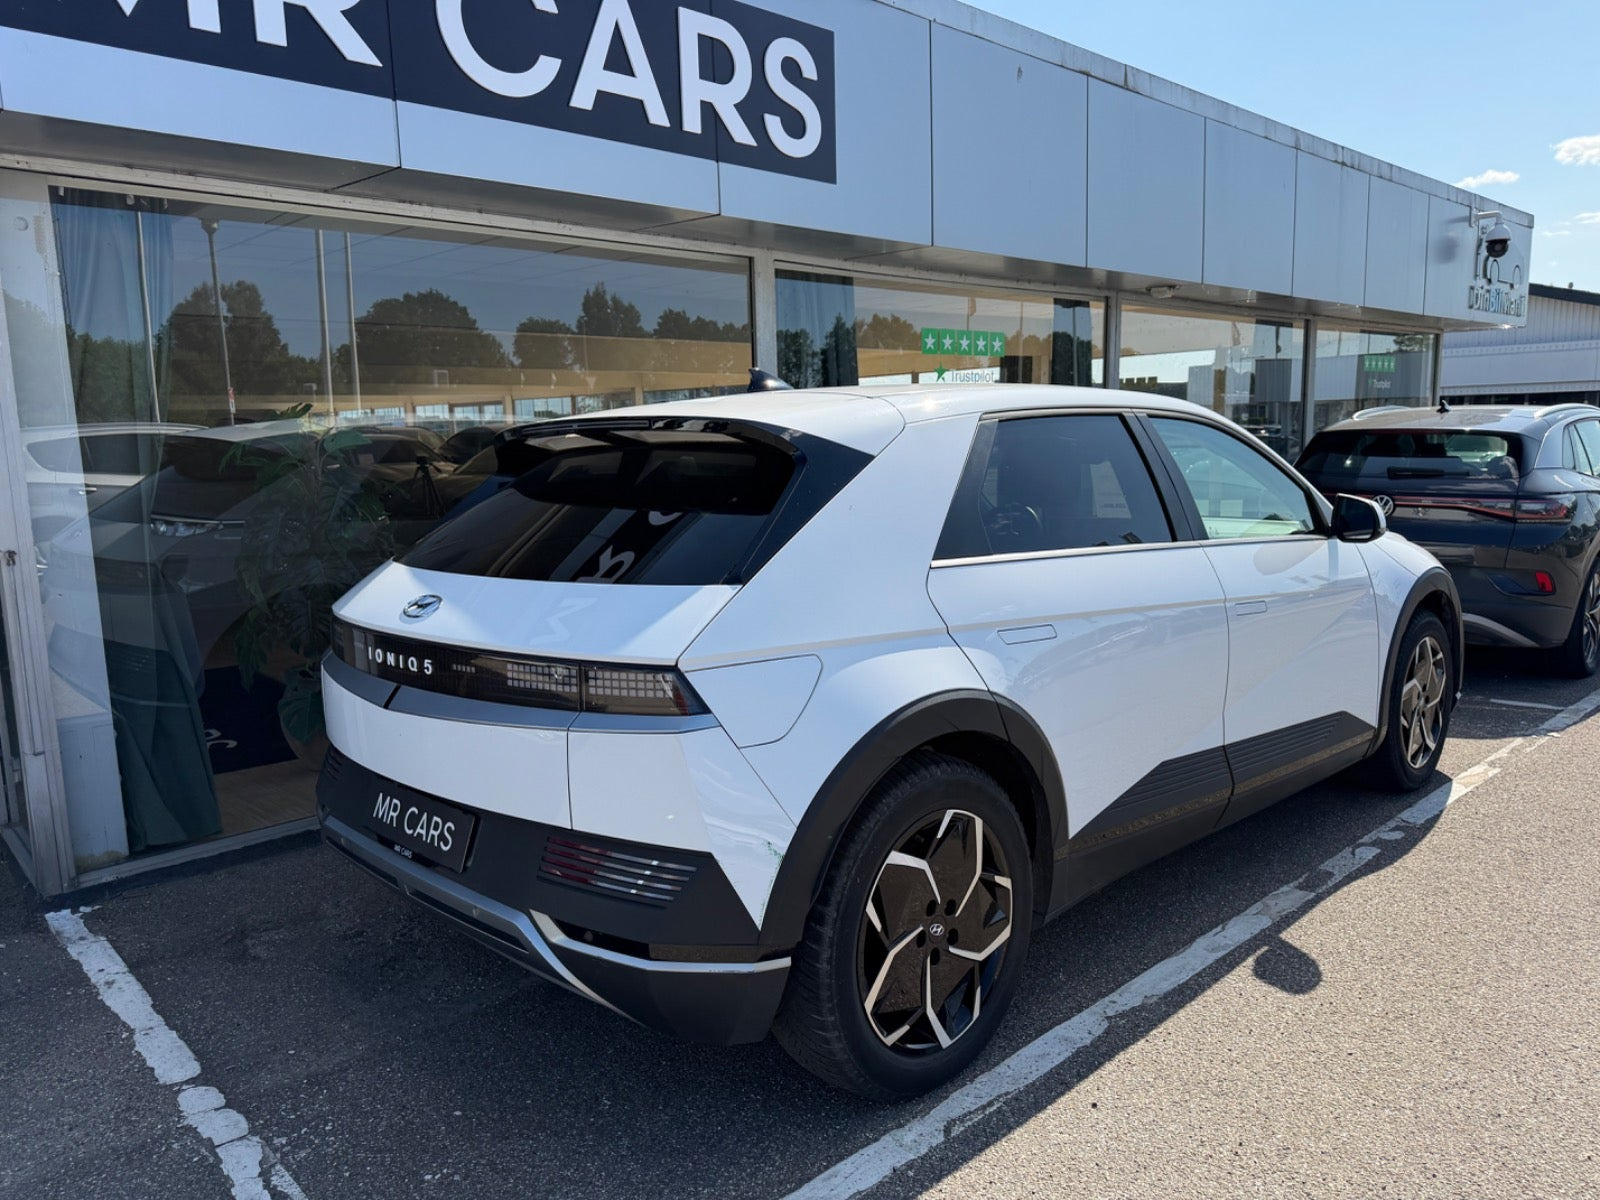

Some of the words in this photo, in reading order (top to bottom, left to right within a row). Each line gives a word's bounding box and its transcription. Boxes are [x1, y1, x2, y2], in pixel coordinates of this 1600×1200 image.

[436, 0, 823, 159] CARS
[951, 370, 995, 384] Trustpilot
[367, 645, 419, 673] IONIQ
[423, 659, 433, 675] 5
[372, 792, 401, 828] MR
[403, 806, 456, 852] CARS
